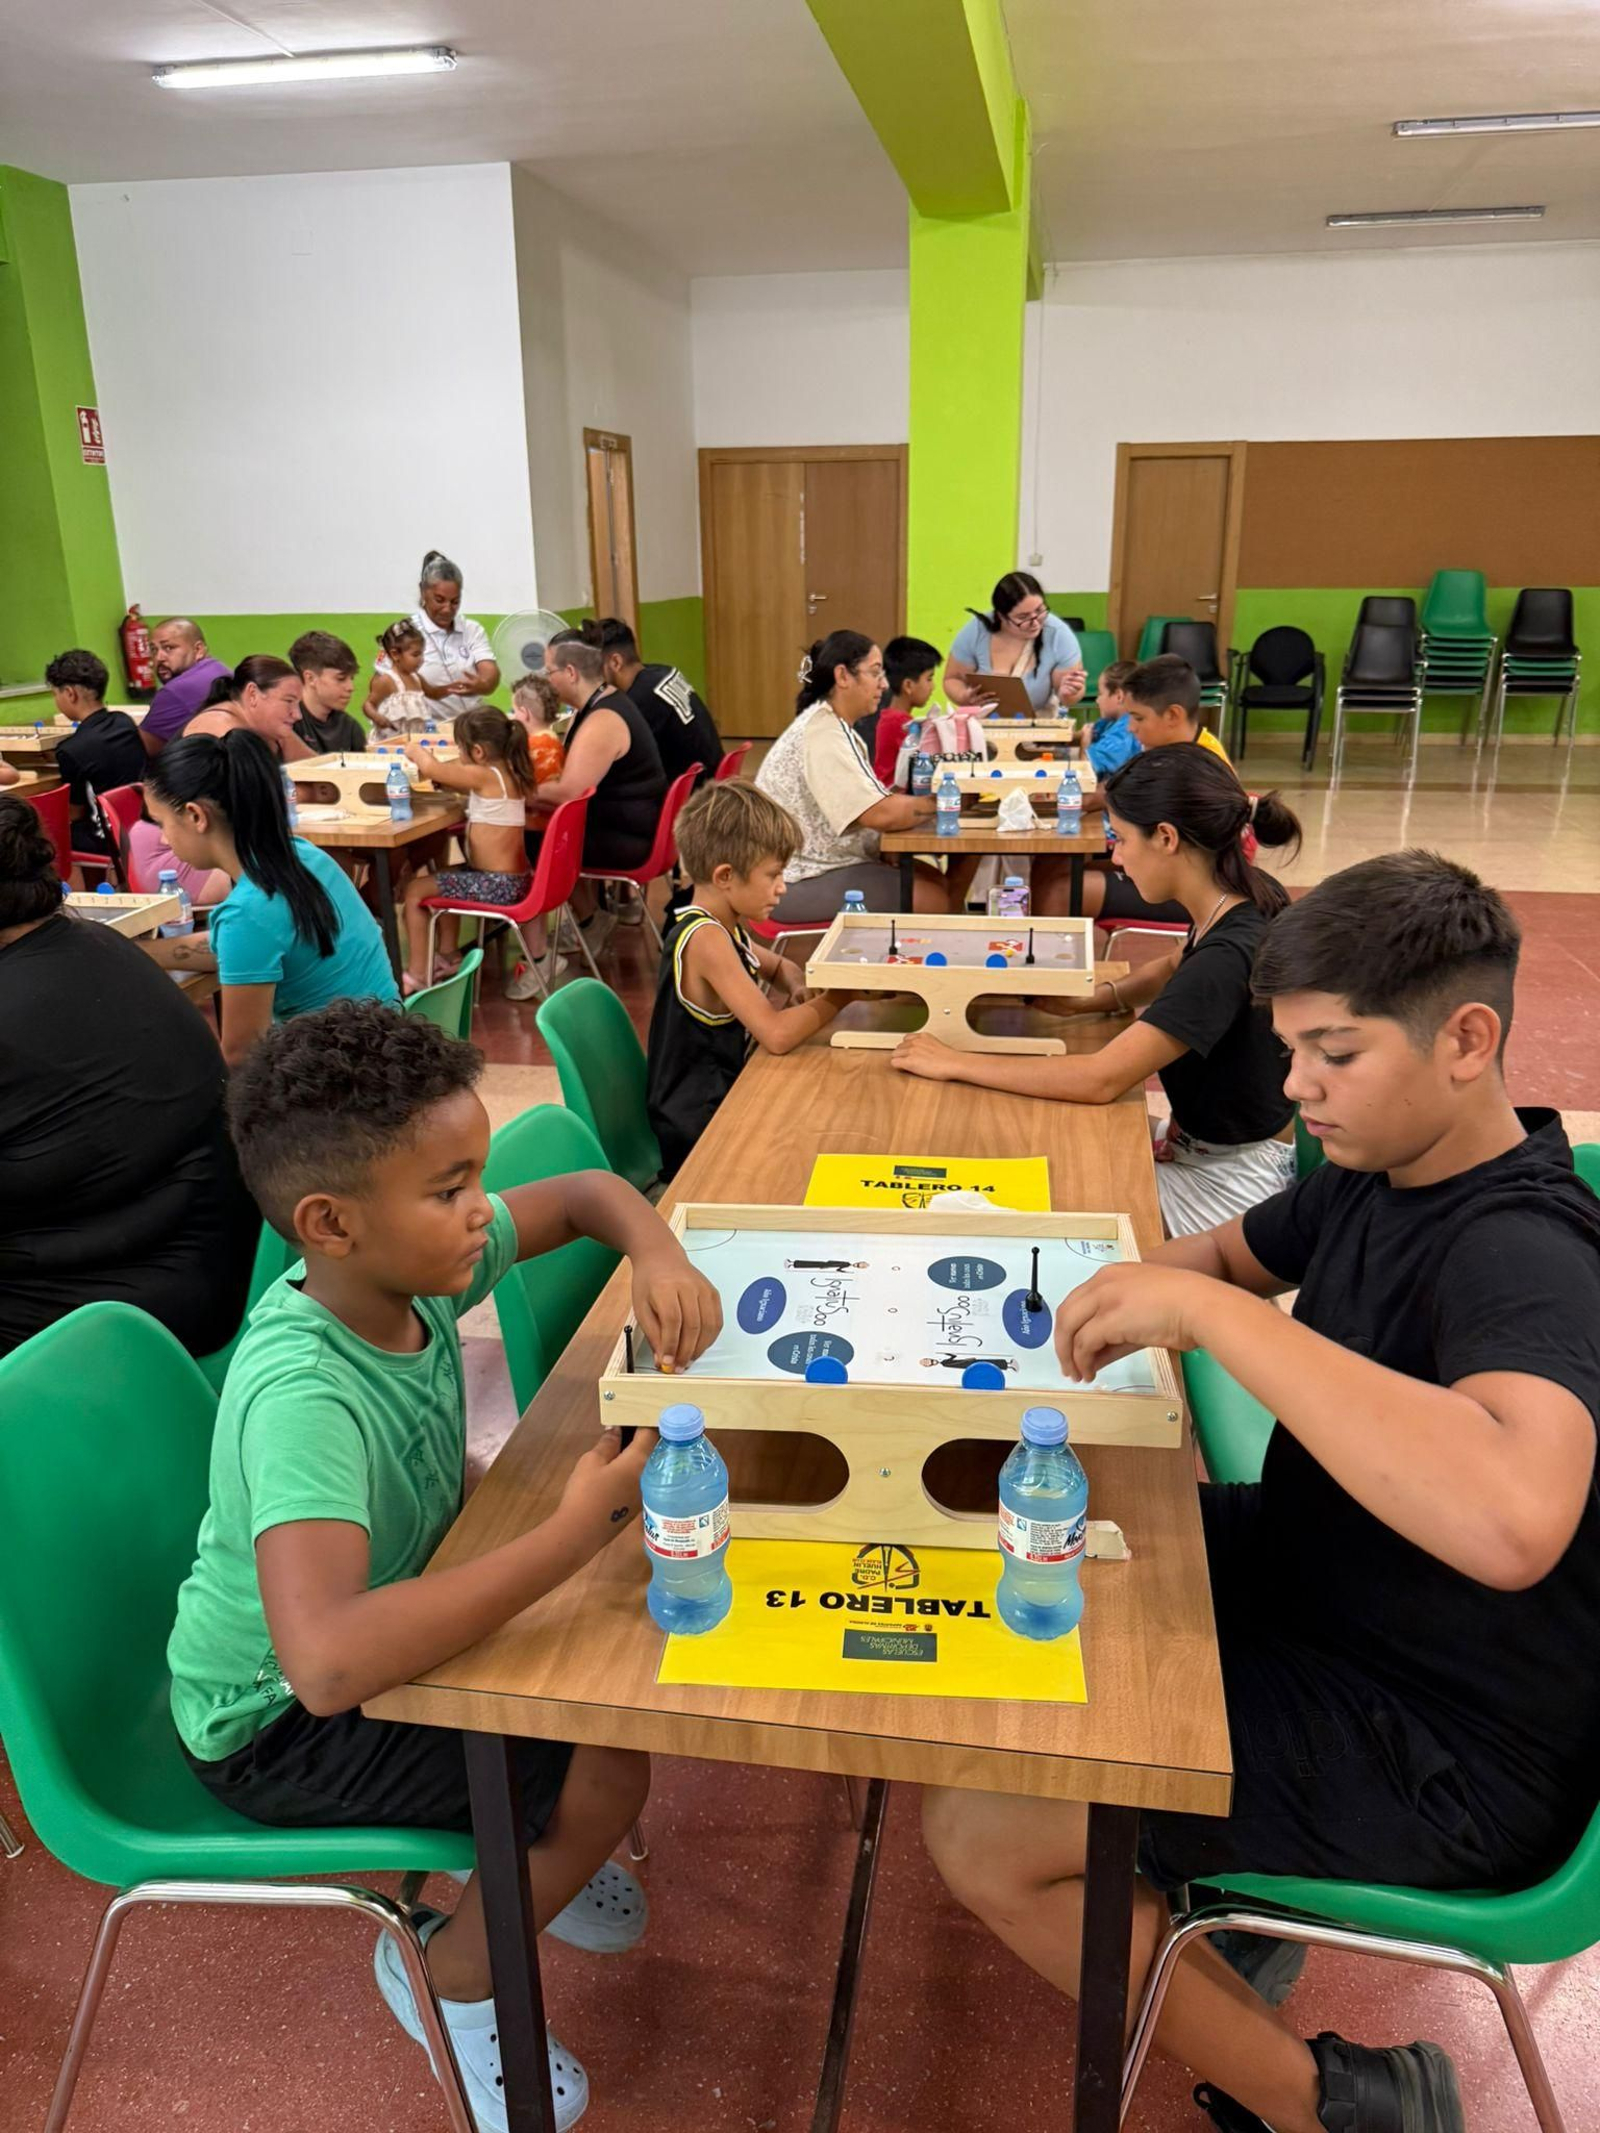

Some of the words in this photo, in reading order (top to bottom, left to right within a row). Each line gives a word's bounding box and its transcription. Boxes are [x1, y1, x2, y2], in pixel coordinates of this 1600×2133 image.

[860, 1179, 963, 1192] TABLERO
[969, 1185, 996, 1193] 14
[765, 1589, 807, 1608] 13
[819, 1591, 992, 1618] TABLERO
